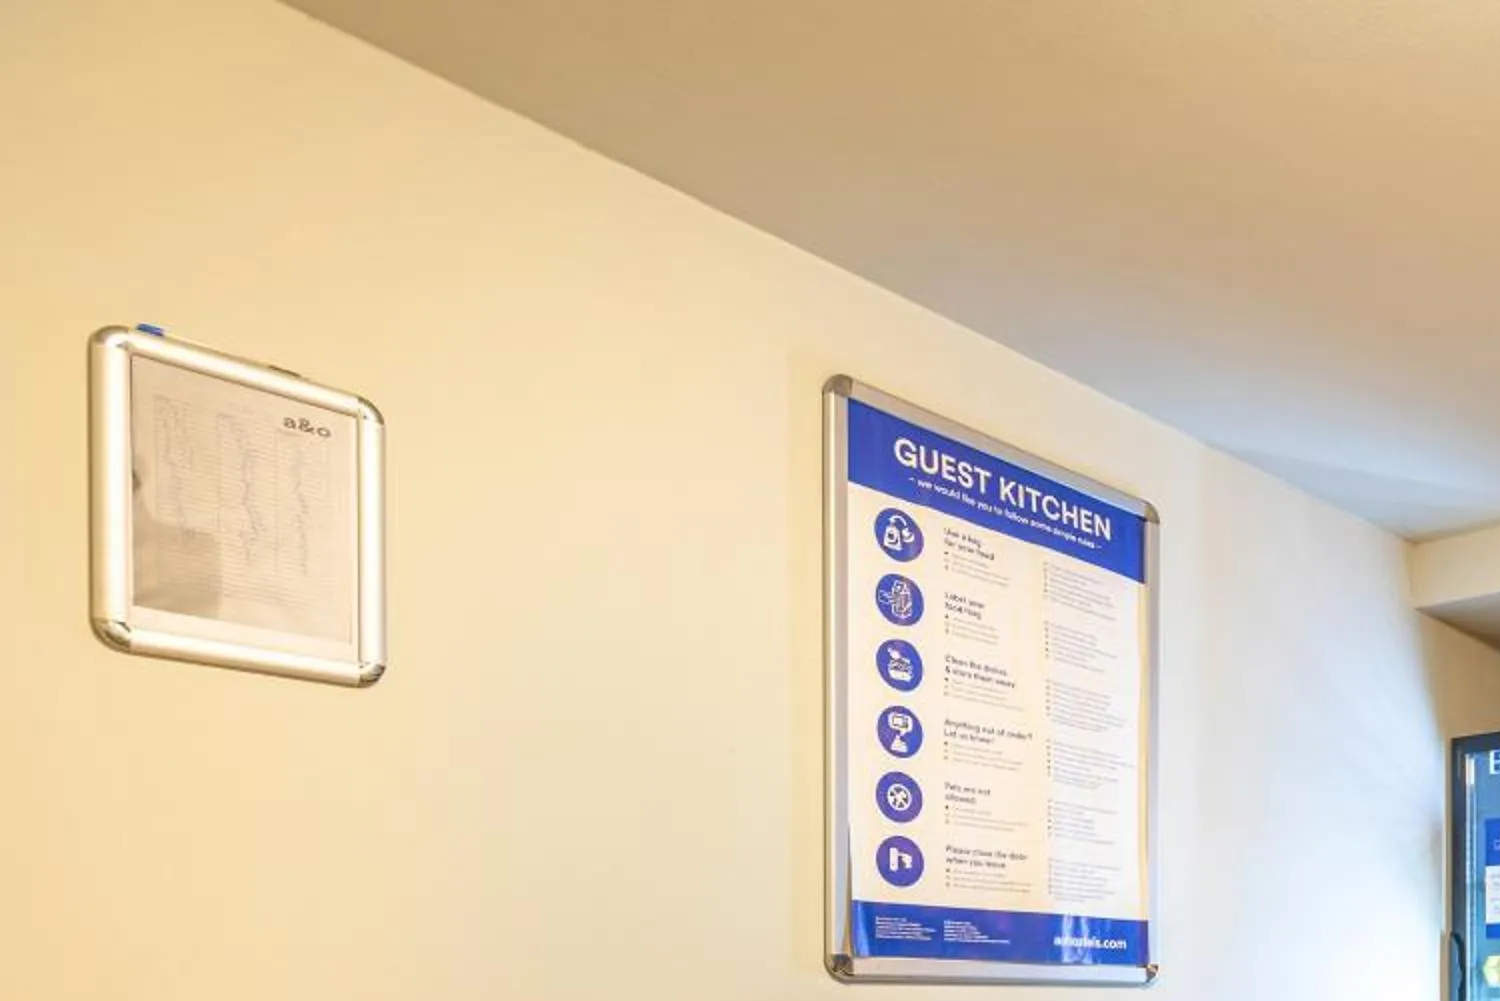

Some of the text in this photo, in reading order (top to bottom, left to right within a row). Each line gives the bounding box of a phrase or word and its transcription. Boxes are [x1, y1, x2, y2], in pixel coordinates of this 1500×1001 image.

[283, 416, 332, 438] a&o
[894, 438, 1112, 541] GUEST KITCHEN
[918, 480, 932, 490] we
[935, 484, 961, 499] would
[962, 491, 974, 506] like
[977, 499, 993, 513] you
[994, 504, 1003, 515] to
[1004, 507, 1029, 525] follow
[1030, 519, 1053, 533] some
[944, 655, 968, 666] Clean
[970, 661, 981, 670] the
[944, 719, 980, 734] Anything
[982, 726, 995, 735] out
[944, 728, 957, 738] Let
[963, 786, 976, 794] are
[978, 787, 991, 796] not
[945, 845, 971, 856] Please
[994, 850, 1007, 859] the
